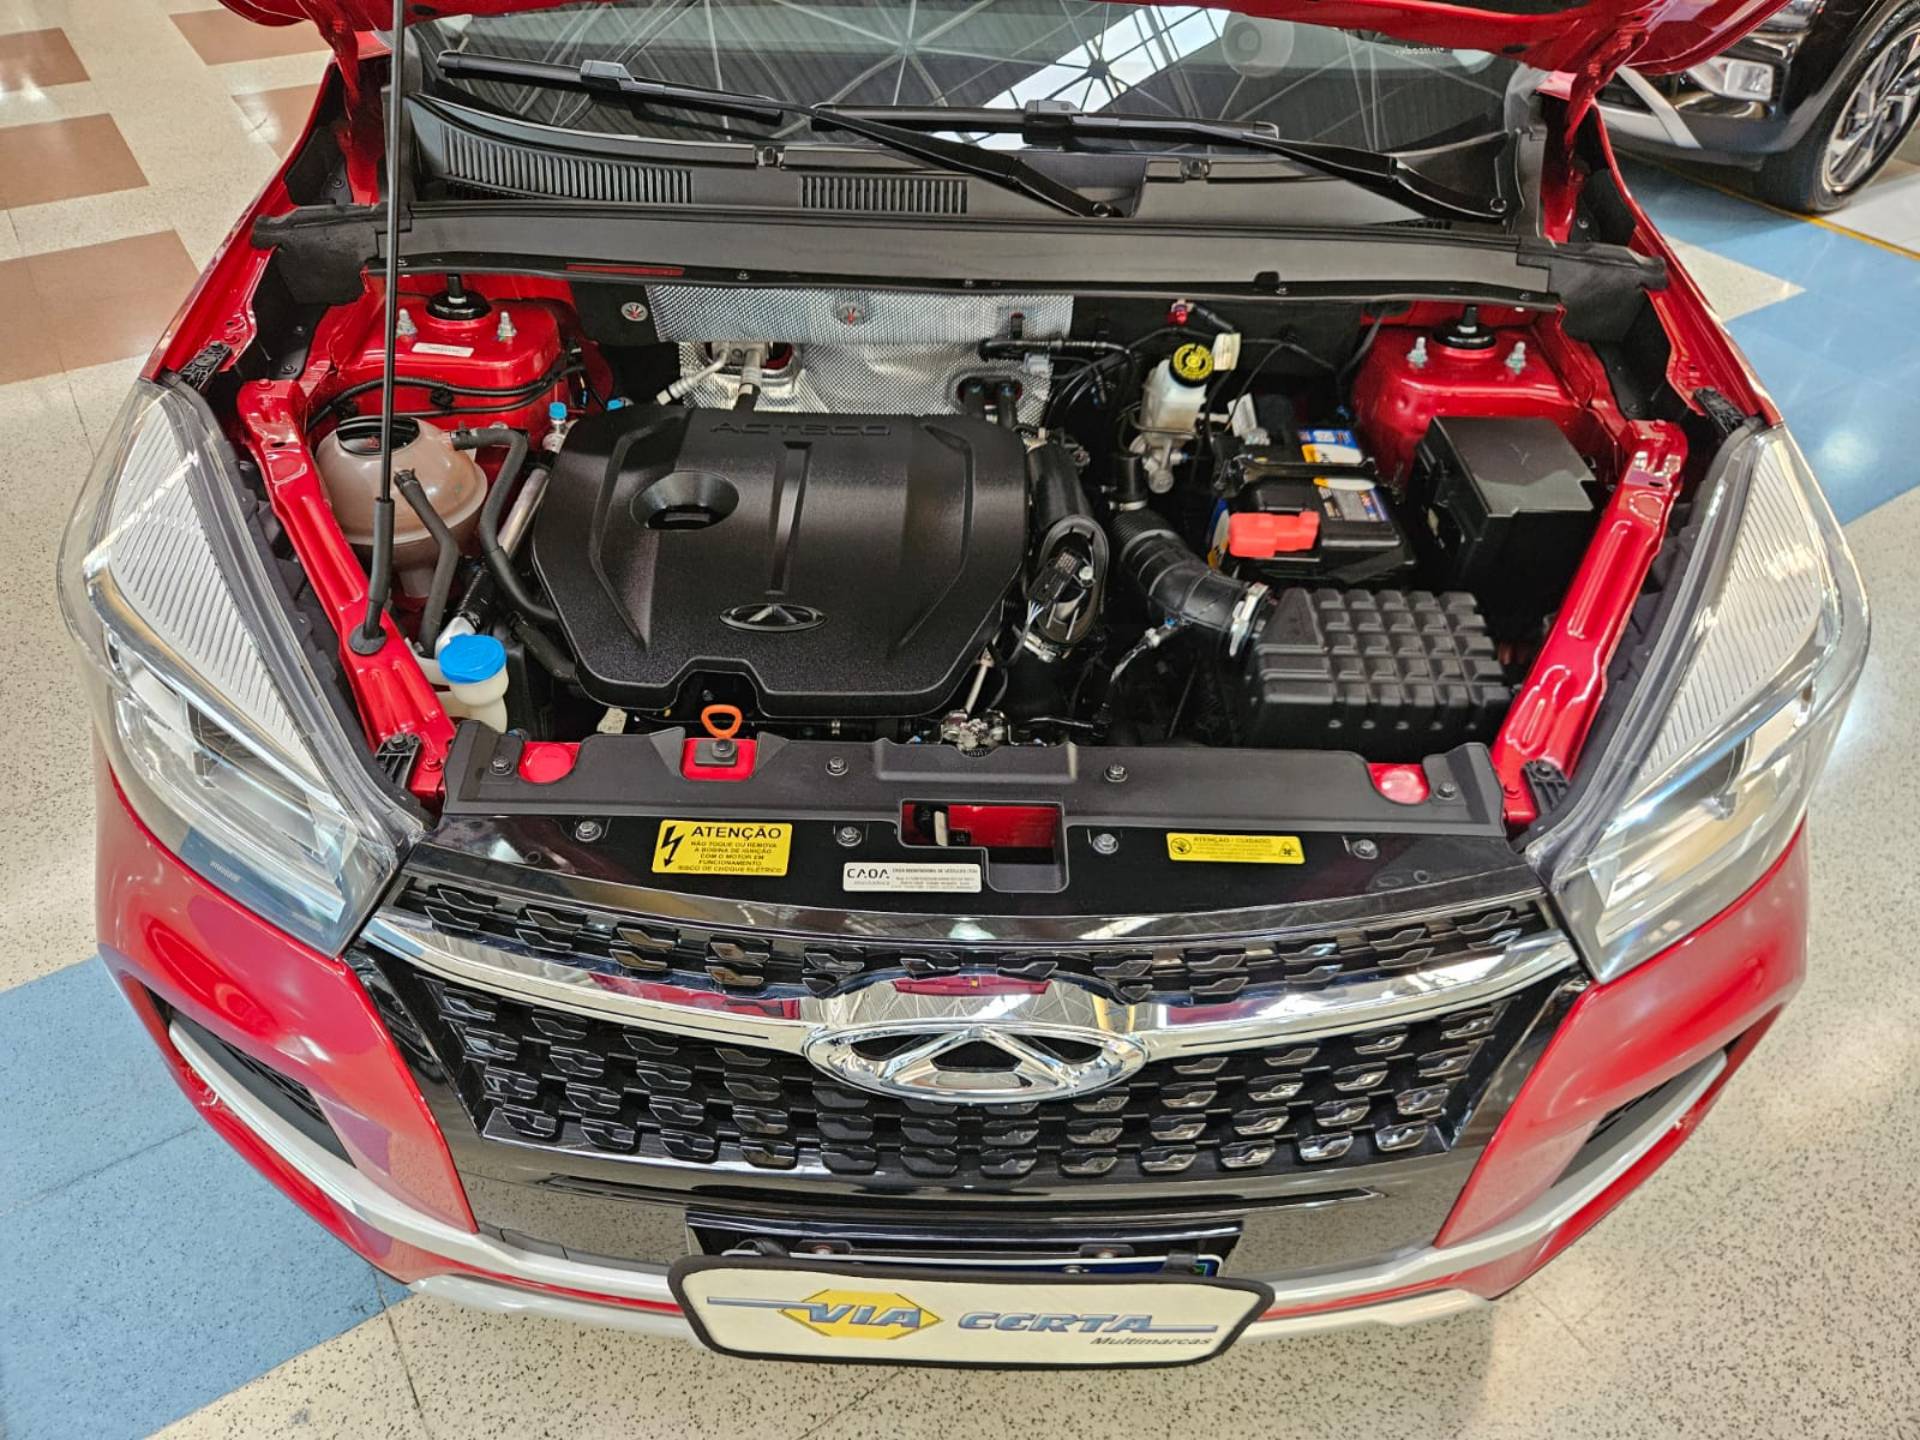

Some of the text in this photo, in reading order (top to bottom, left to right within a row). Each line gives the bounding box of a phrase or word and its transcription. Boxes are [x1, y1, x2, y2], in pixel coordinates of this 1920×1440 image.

[710, 423, 891, 436] ACTECO
[691, 826, 783, 840] ATENÇÃO
[846, 868, 890, 879] CAOA
[809, 1303, 1152, 1333] VIA CERTA
[1090, 1336, 1214, 1345] Multimarcas
